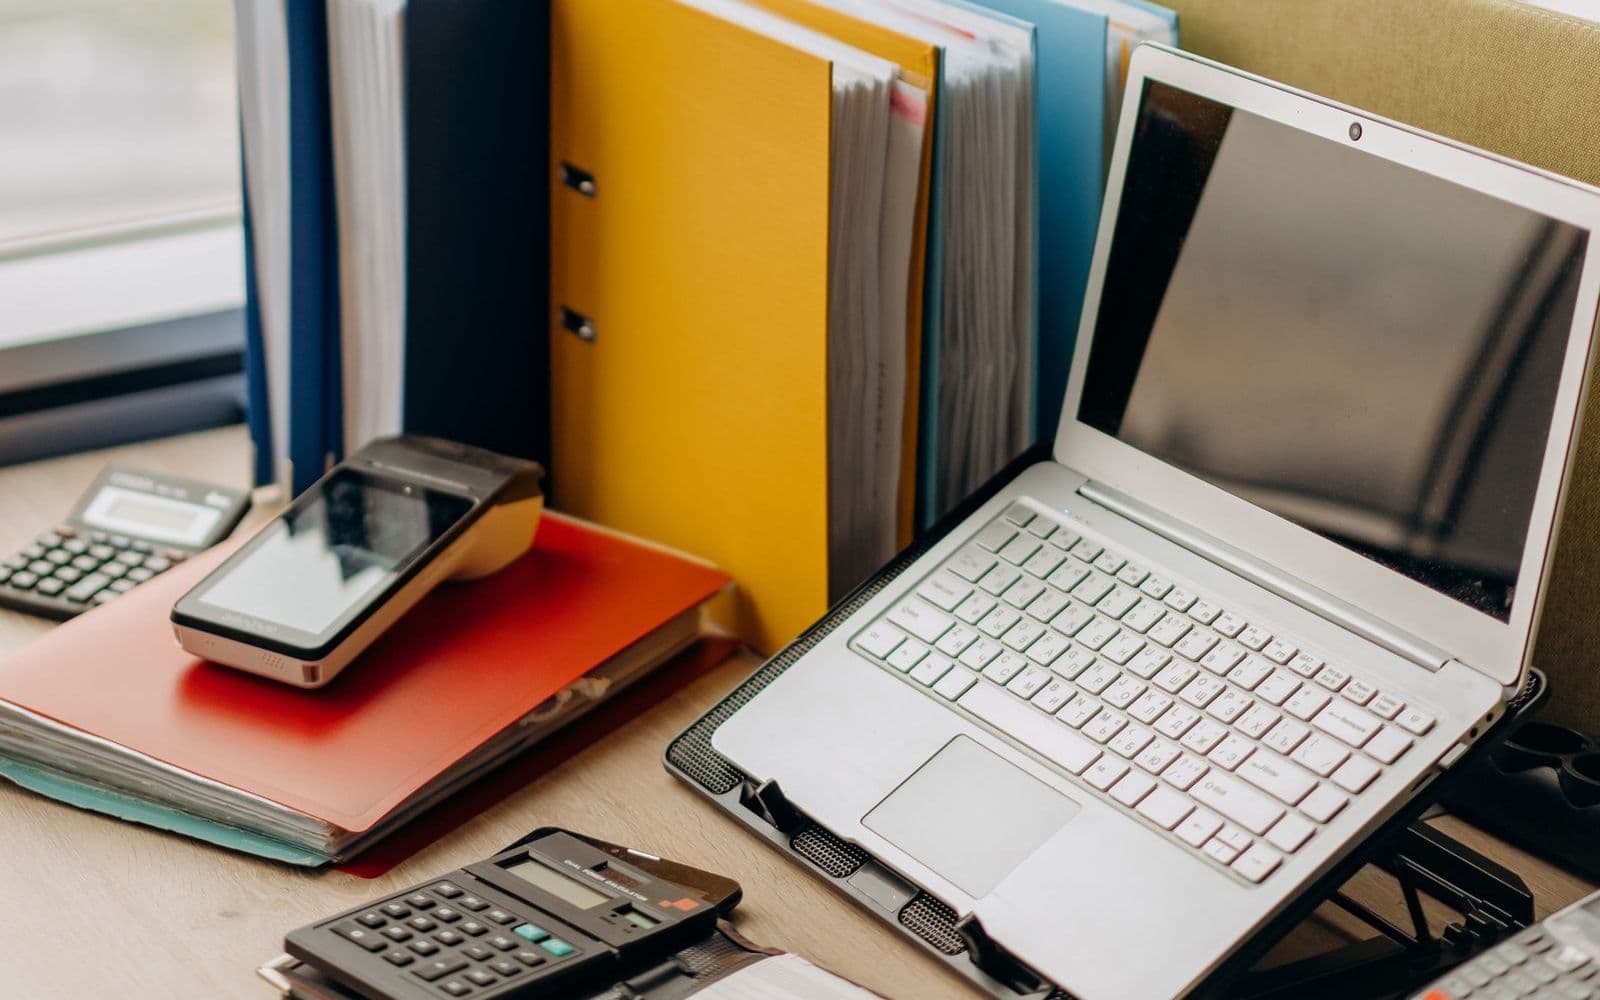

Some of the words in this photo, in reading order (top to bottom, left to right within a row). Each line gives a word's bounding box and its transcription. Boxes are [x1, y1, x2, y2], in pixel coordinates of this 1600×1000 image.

[1068, 650, 1079, 659] G
[1144, 648, 1155, 656] U
[1001, 655, 1010, 663] C
[1093, 664, 1104, 672] H
[1049, 683, 1060, 691] B
[1145, 693, 1158, 701] K
[1224, 692, 1235, 700] P
[1171, 707, 1181, 717] L
[1099, 712, 1112, 721] M
[1148, 756, 1161, 766] Ю
[564, 859, 581, 870] DUAL
[605, 880, 648, 901] CALCULATOR
